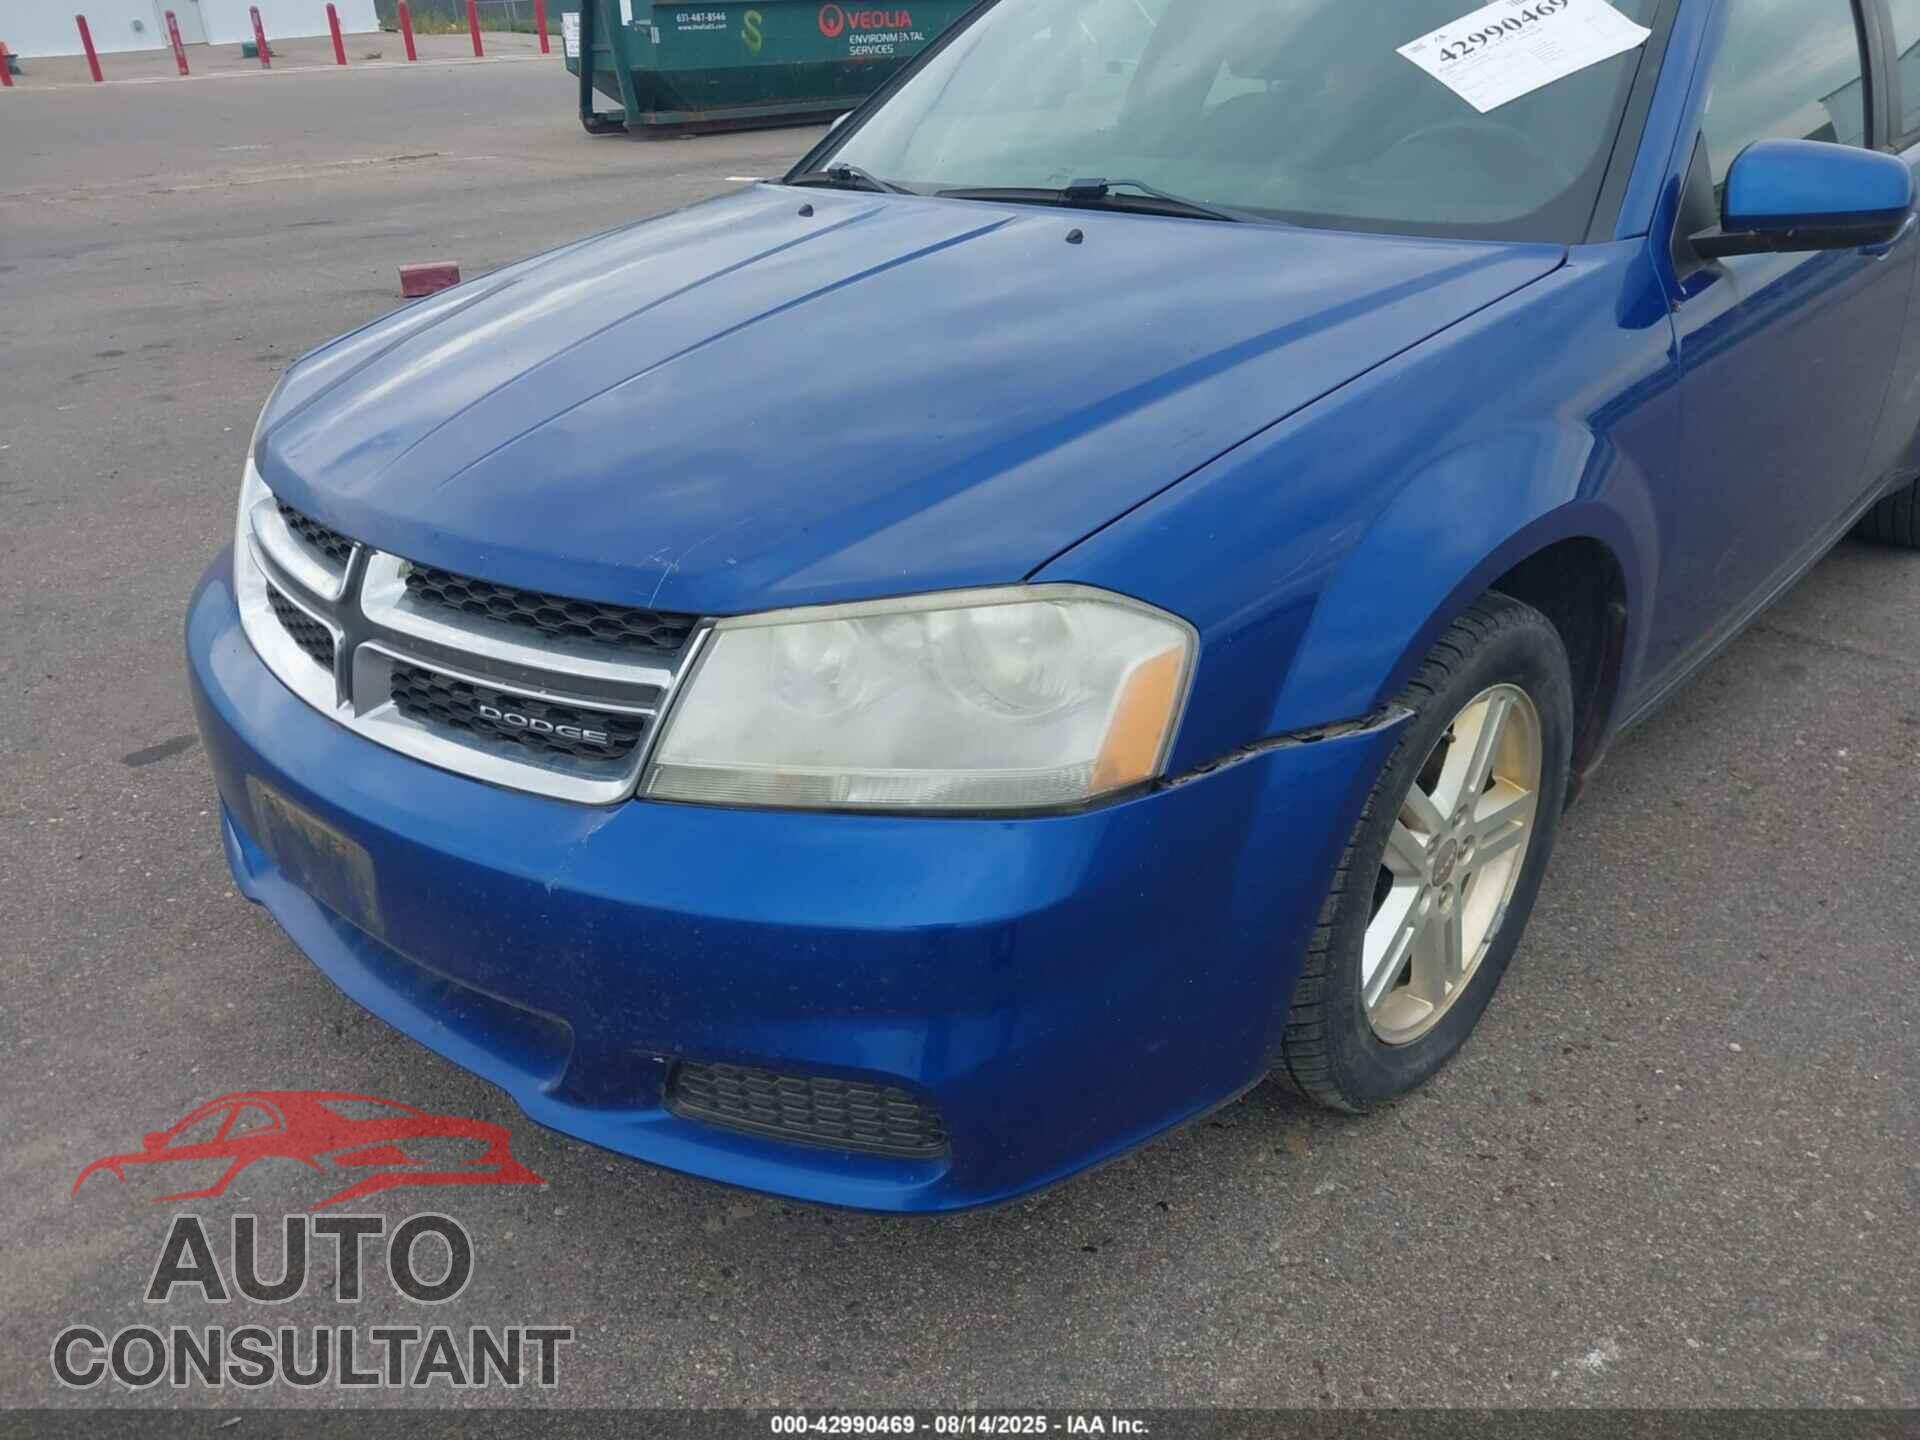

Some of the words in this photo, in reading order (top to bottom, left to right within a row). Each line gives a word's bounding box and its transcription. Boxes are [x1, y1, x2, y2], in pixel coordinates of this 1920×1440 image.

[848, 9, 912, 29] VEOLIA
[849, 32, 925, 44] ENVIRONMENTAL
[1439, 0, 1569, 63] 42990469
[849, 44, 894, 55] SERVICES
[480, 705, 608, 744] DODGE
